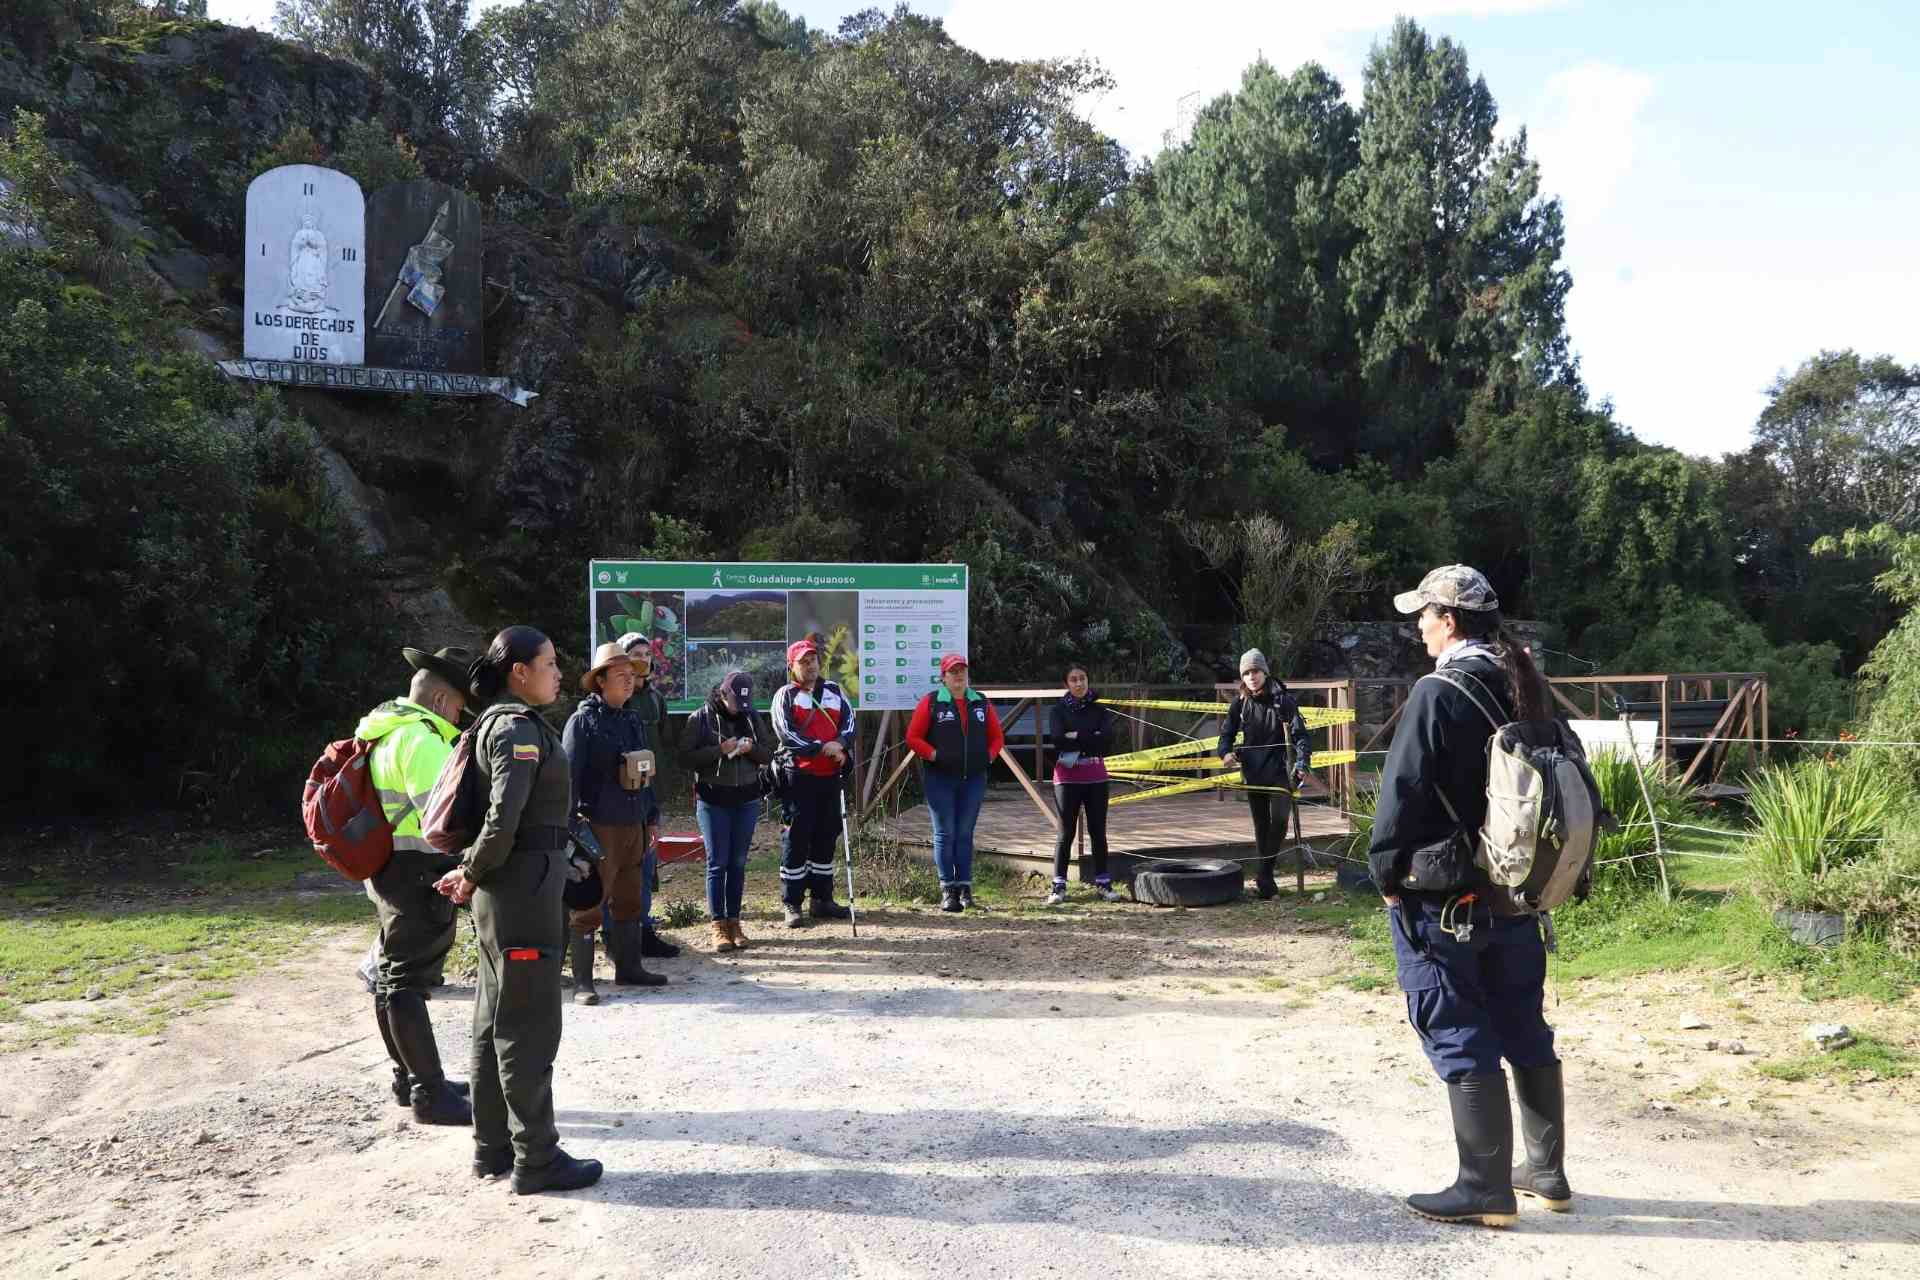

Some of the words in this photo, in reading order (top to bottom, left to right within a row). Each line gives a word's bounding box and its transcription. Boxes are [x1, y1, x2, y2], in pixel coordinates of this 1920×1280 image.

[255, 311, 283, 327] LOS
[285, 315, 355, 334] DERECHOS
[300, 332, 320, 346] DE
[293, 345, 328, 361] DIOS
[268, 363, 337, 385] PODER
[748, 574, 856, 586] Guadalupe-Aguanoso
